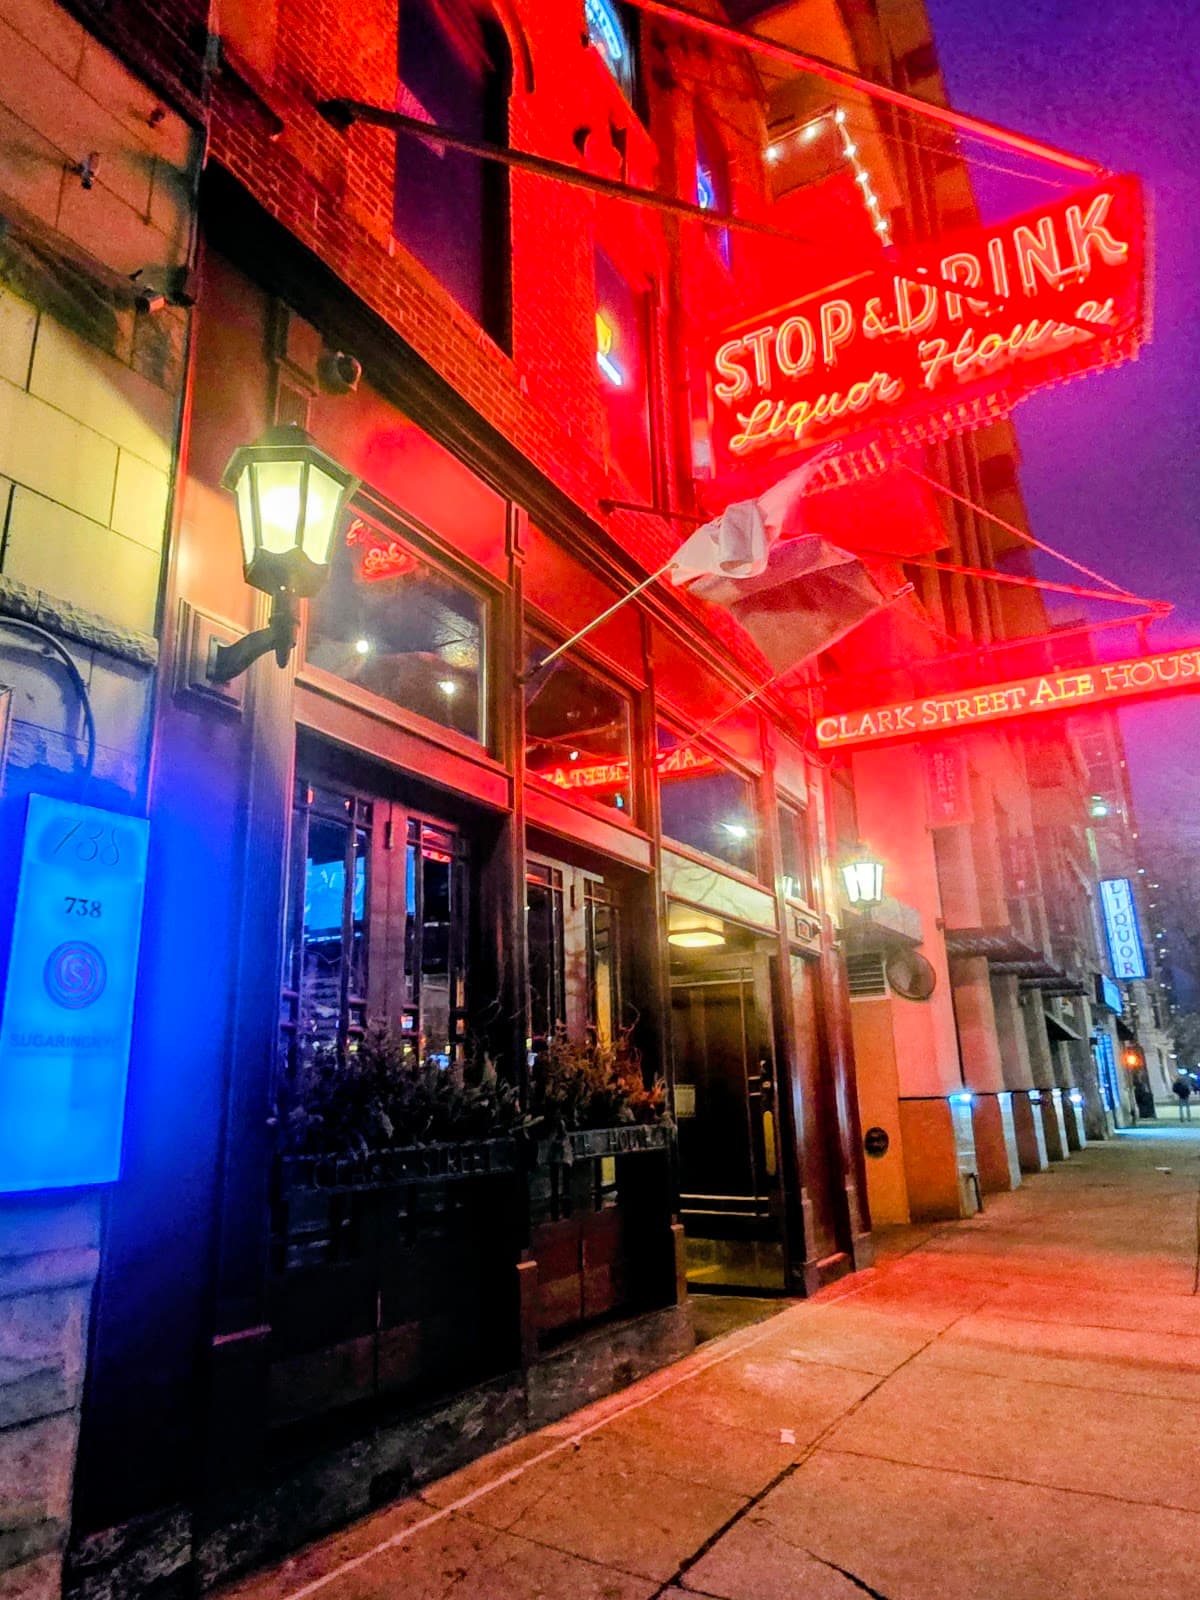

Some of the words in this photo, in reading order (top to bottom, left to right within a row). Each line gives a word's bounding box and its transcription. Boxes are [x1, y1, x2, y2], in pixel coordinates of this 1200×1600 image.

[715, 299, 853, 399] STOP
[862, 297, 900, 336] &
[893, 193, 1128, 333] DRINK
[729, 371, 899, 451] Liquor
[816, 706, 916, 742] CLARK
[921, 687, 1025, 727] STREET
[1030, 674, 1095, 706] ALE
[63, 896, 103, 918] 738
[1110, 882, 1135, 975] LIQUOR
